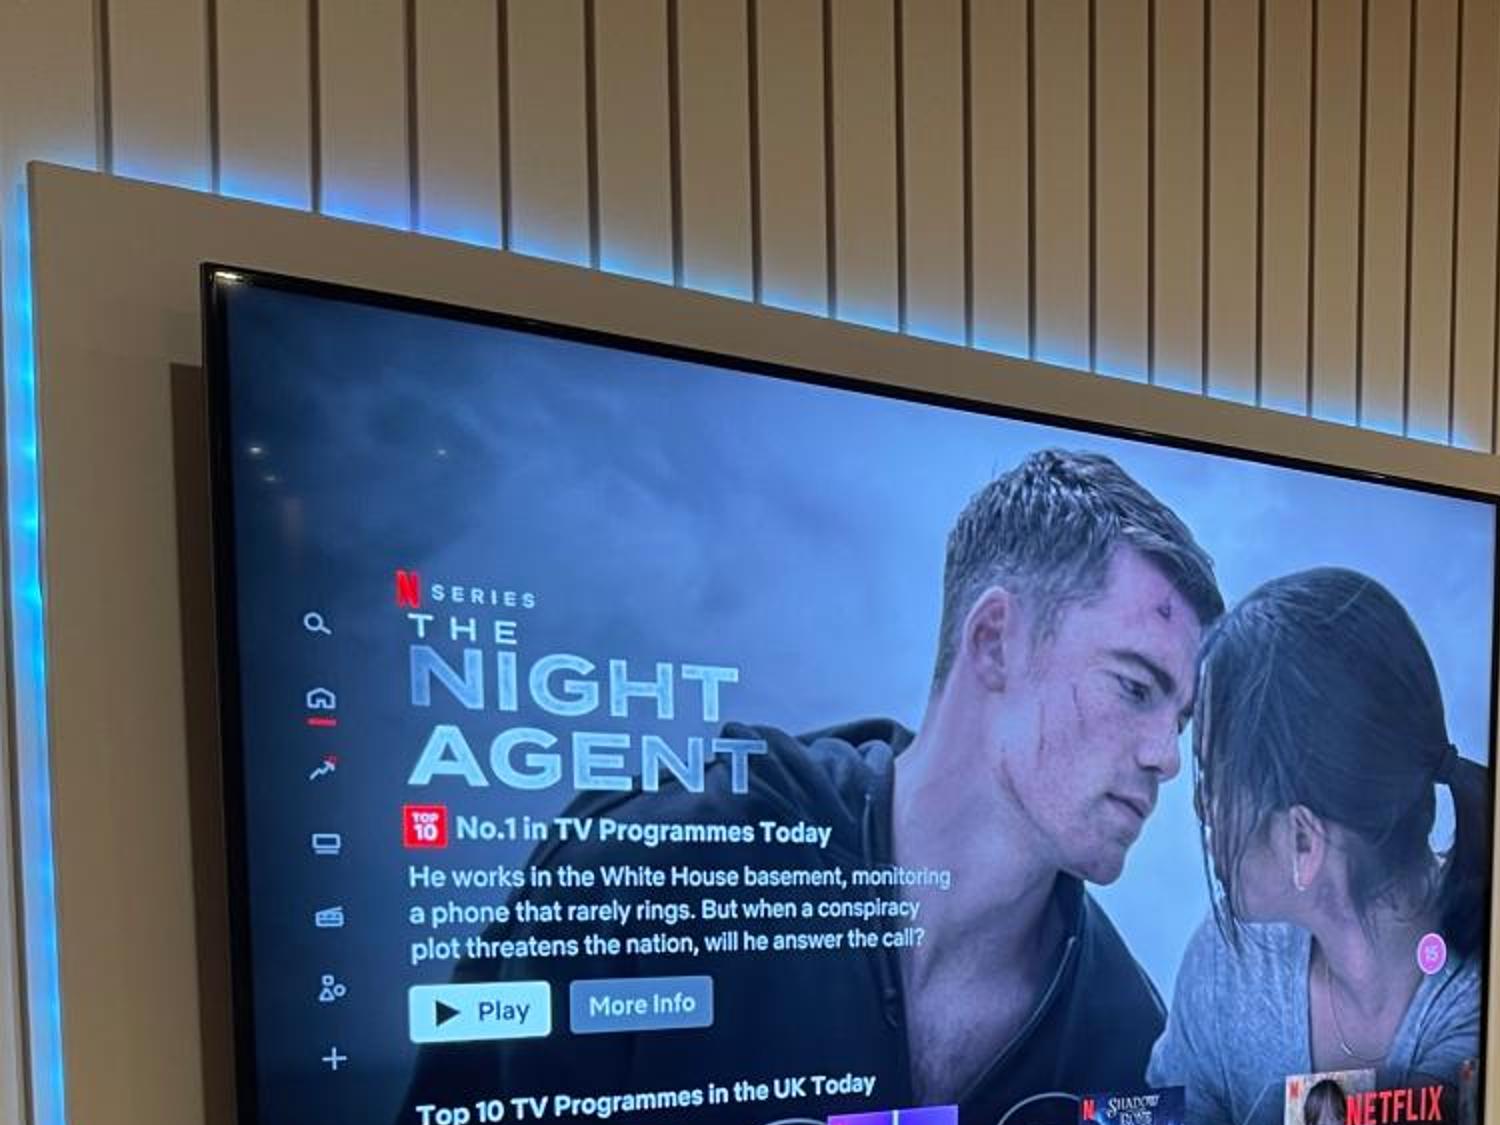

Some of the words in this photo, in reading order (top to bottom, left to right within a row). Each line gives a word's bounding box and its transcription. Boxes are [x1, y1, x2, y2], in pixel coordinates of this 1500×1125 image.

[395, 570, 420, 608] N
[431, 584, 536, 609] SERIES
[407, 612, 518, 645] THE
[409, 644, 739, 722] NIGHT
[407, 724, 767, 794] AGENT
[412, 812, 439, 824] TOP
[413, 823, 438, 841] 10
[456, 816, 516, 840] No.1
[523, 816, 548, 840] in
[554, 818, 592, 841] TV
[600, 819, 755, 847] Programmes
[759, 821, 832, 848] Today
[409, 866, 446, 888] He
[452, 866, 525, 888] works
[531, 866, 552, 887] in
[557, 866, 595, 887] the
[601, 866, 666, 887] White
[671, 866, 739, 887] House
[744, 866, 847, 889] basement,
[852, 867, 951, 890] monitoring
[409, 906, 425, 925] a
[431, 901, 510, 928] phone
[515, 900, 563, 923] that
[568, 900, 632, 925] rarely
[636, 900, 696, 924] rings.
[701, 899, 738, 919] But
[742, 898, 797, 919] when
[801, 902, 813, 918] a
[818, 898, 920, 920] conspiracy
[411, 937, 461, 965] plot
[466, 936, 579, 959] threatens
[584, 934, 620, 956] the
[626, 933, 699, 956] nation,
[704, 931, 738, 951] will
[744, 931, 769, 951] he
[773, 932, 844, 950] answer
[847, 929, 879, 948] the
[882, 928, 926, 947] call?
[478, 1000, 530, 1025] Play
[589, 995, 648, 1018] More
[653, 993, 696, 1015] Info
[476, 1100, 505, 1123] 10
[510, 1098, 549, 1121] TV
[553, 1088, 704, 1118] Programmes
[708, 1083, 729, 1105] in
[732, 1081, 770, 1101] the
[774, 1077, 806, 1098] UK
[811, 1072, 877, 1097] Today
